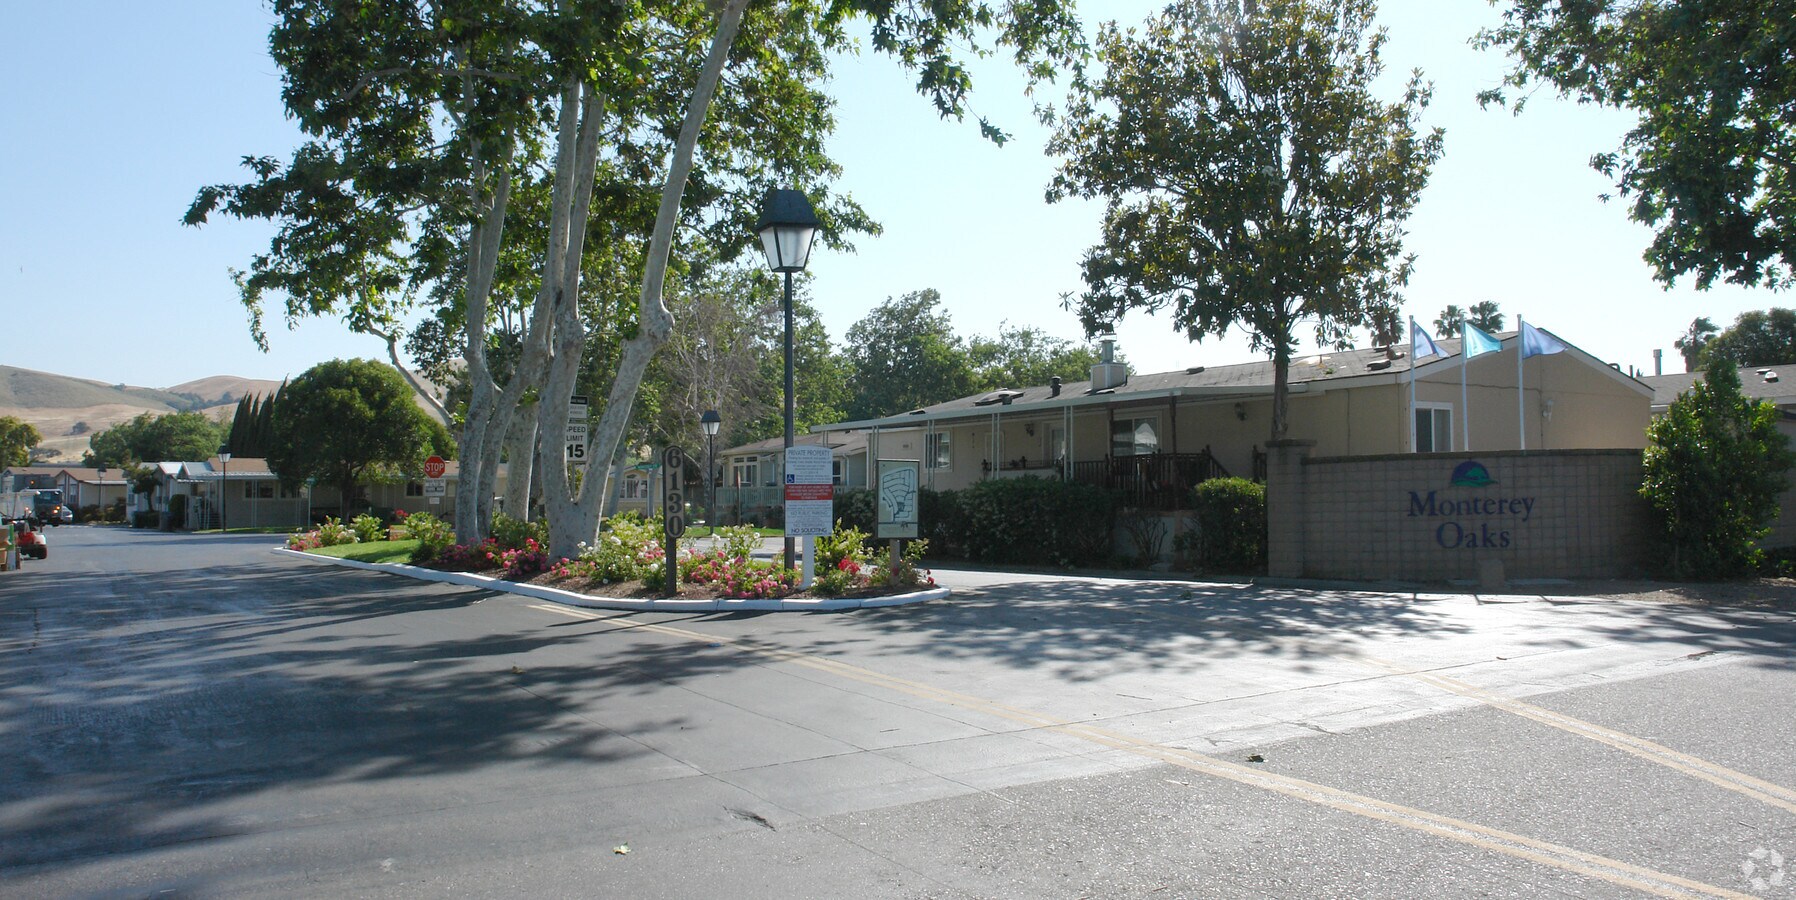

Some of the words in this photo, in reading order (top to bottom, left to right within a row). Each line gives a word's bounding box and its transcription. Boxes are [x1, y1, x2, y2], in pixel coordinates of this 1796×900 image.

[567, 444, 584, 458] 15
[425, 462, 444, 472] STOP
[667, 448, 682, 536] 6130
[1407, 491, 1536, 522] Monterey
[1436, 521, 1511, 549] Oaks
